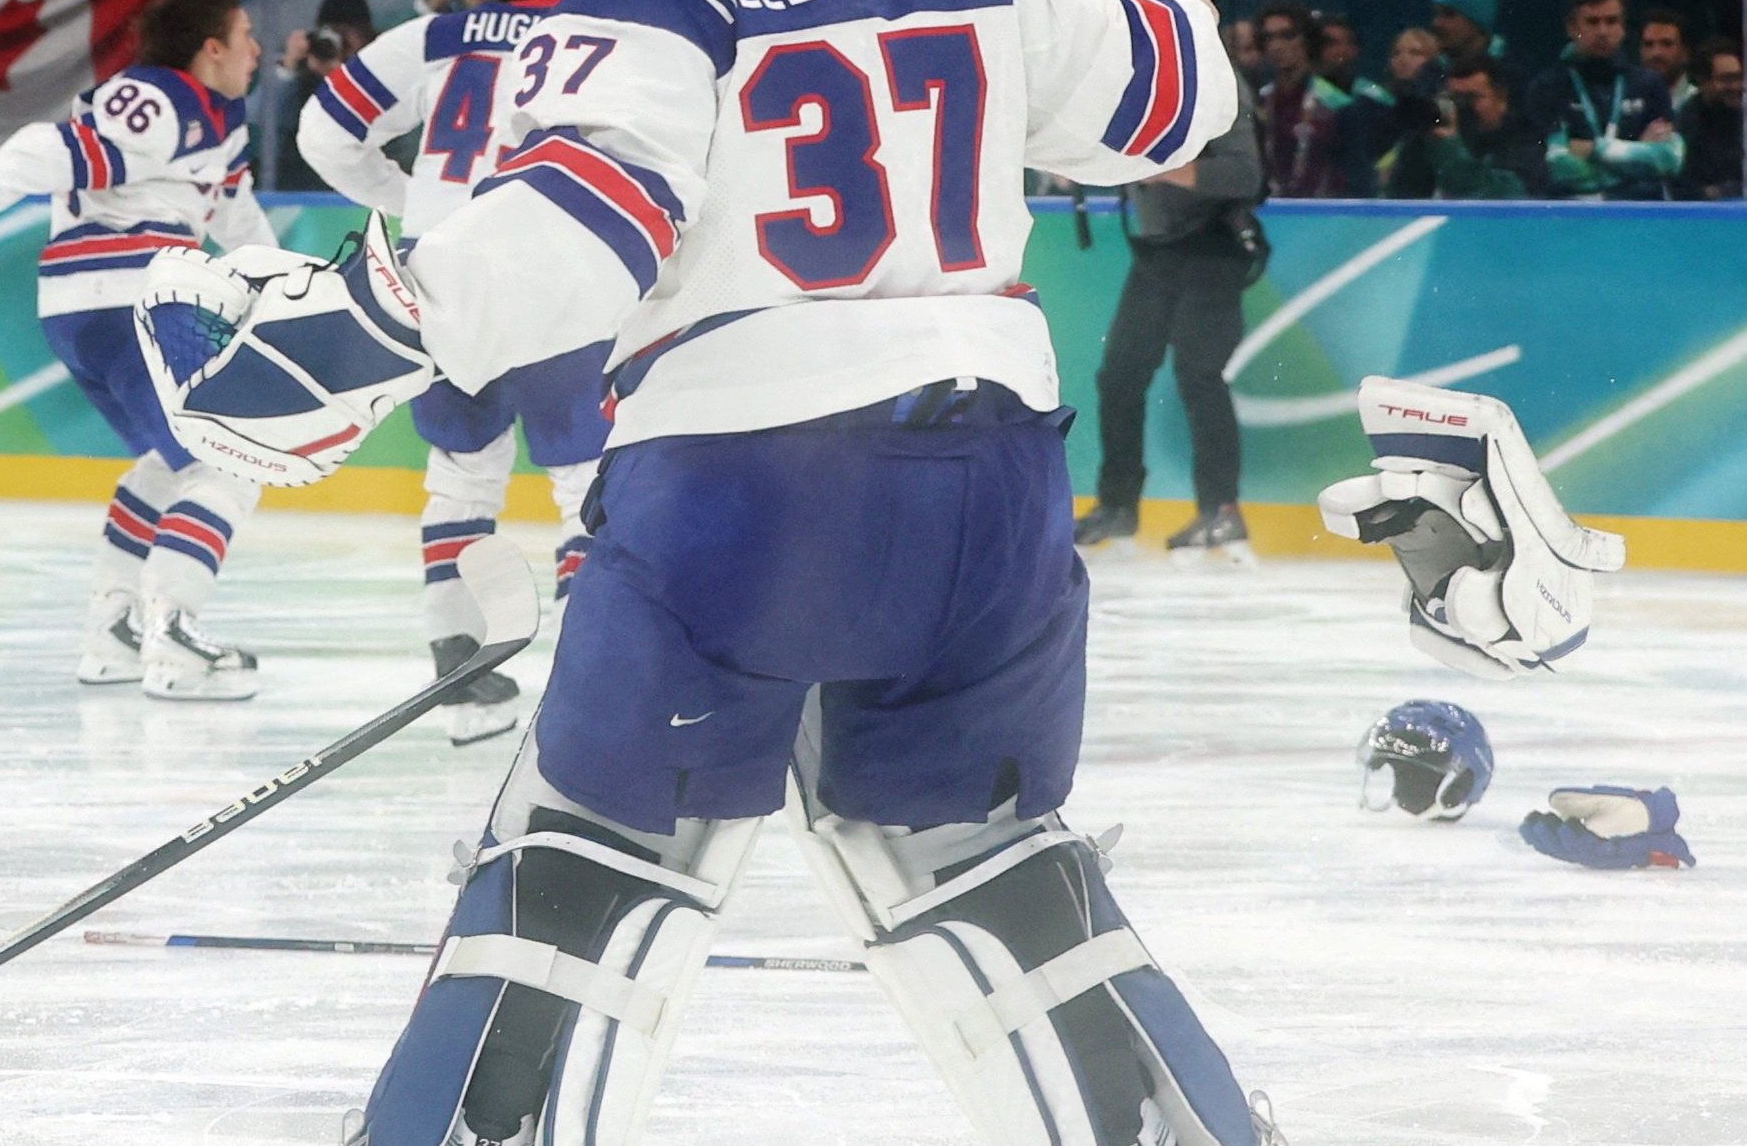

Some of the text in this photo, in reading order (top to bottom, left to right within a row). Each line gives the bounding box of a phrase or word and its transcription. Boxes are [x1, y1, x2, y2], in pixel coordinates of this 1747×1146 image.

[463, 11, 538, 45] HUG
[515, 33, 617, 108] 37
[104, 83, 161, 135] 86
[739, 23, 987, 291] 37
[1378, 404, 1468, 427] TRUE
[763, 957, 852, 973] SHERWOOD
